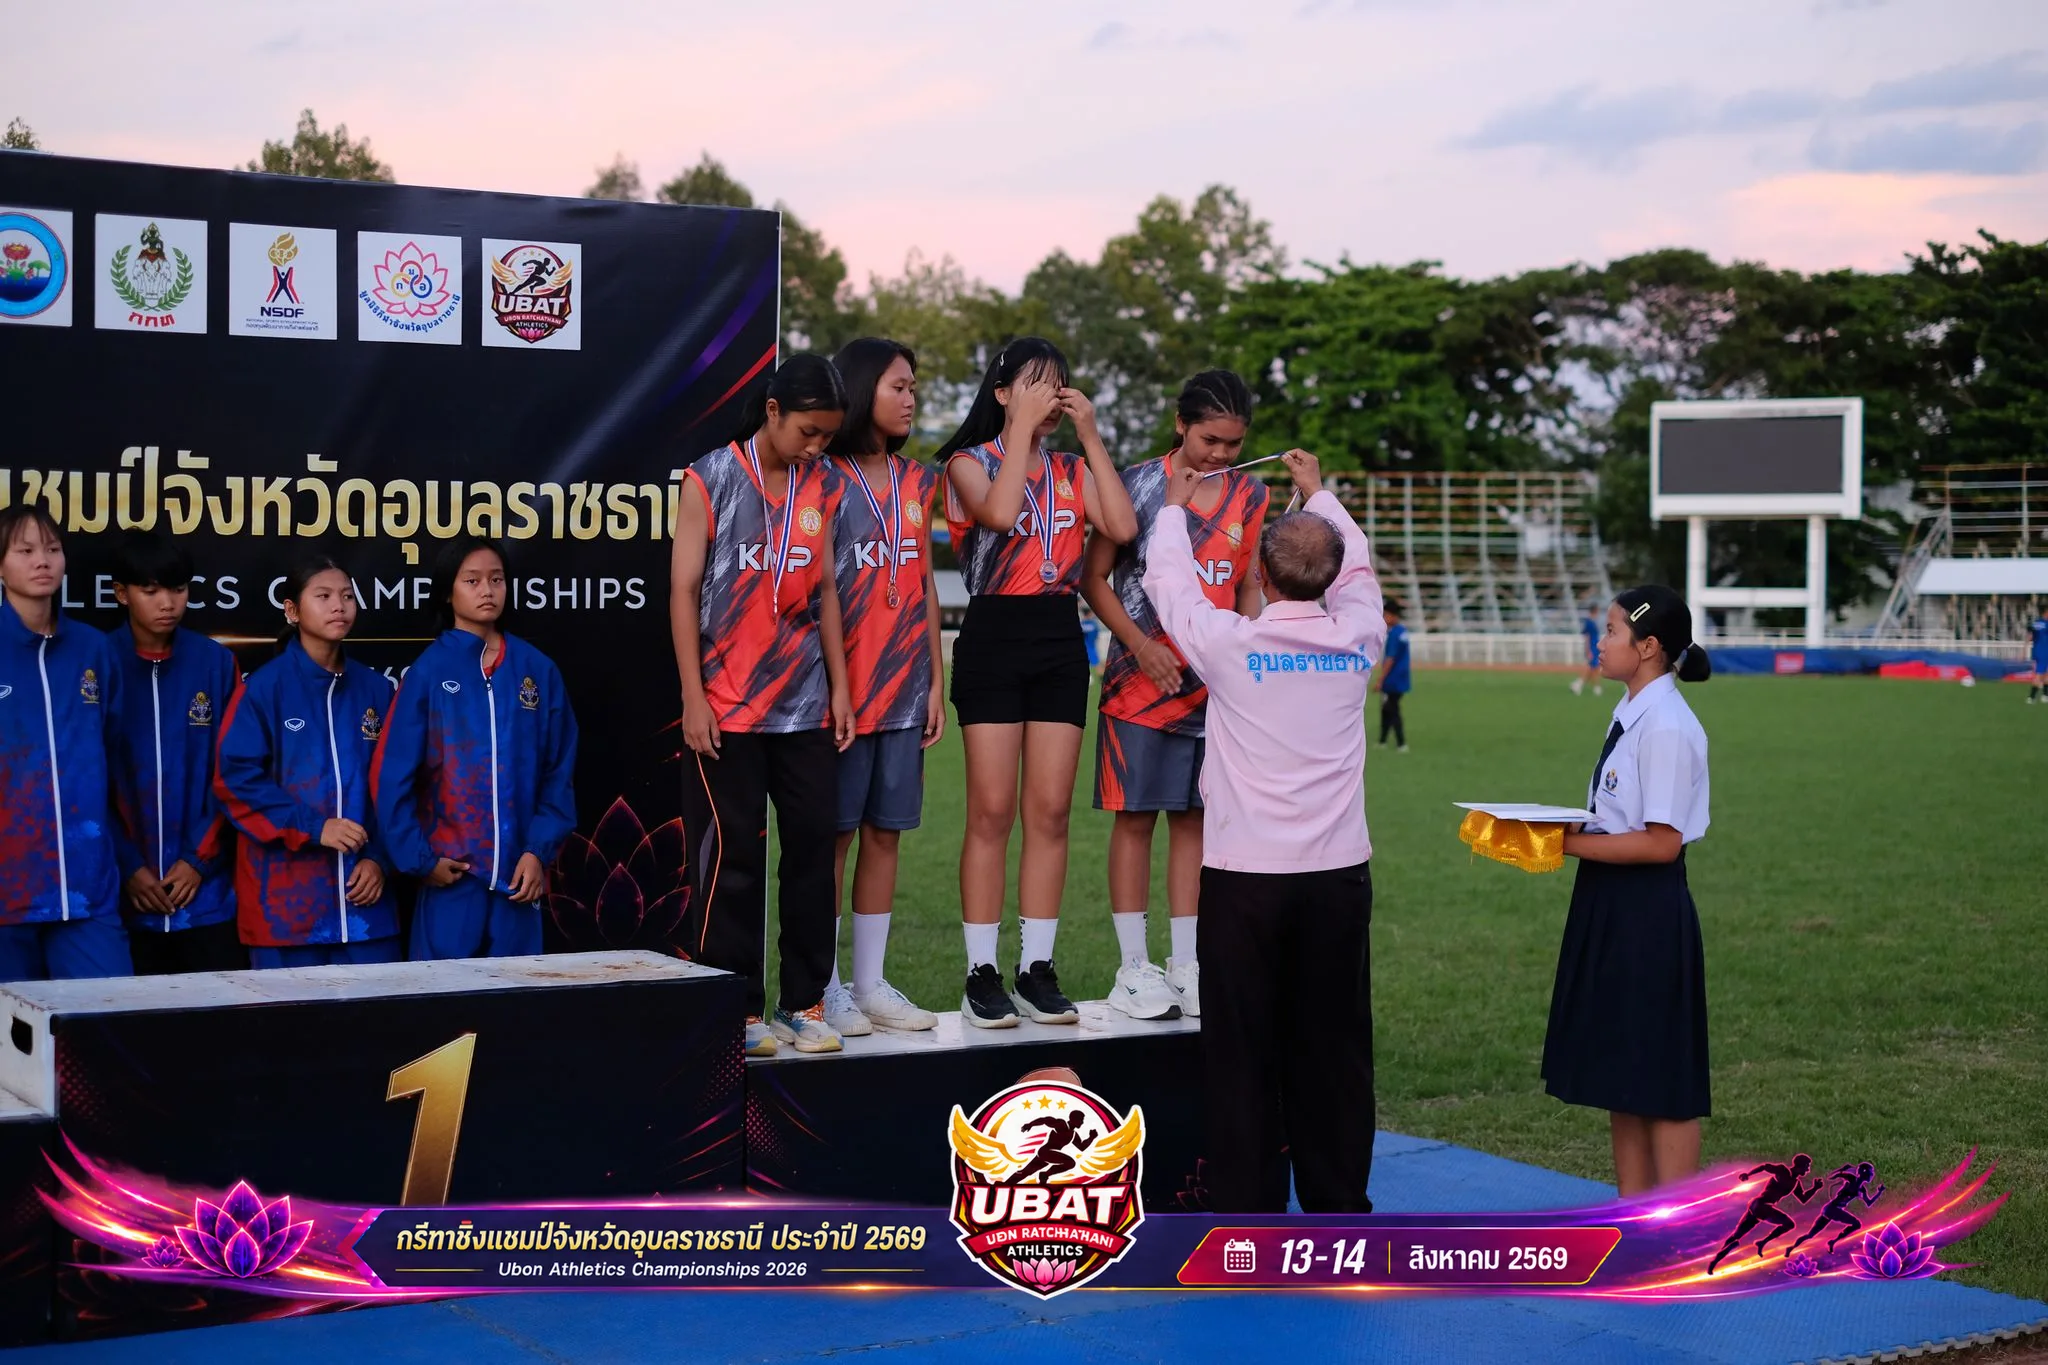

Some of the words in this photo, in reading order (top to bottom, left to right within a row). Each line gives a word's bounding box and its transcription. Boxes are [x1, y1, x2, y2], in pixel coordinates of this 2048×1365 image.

[260, 306, 304, 318] NSDF
[498, 294, 566, 316] UBAT
[386, 1032, 477, 1206] 1
